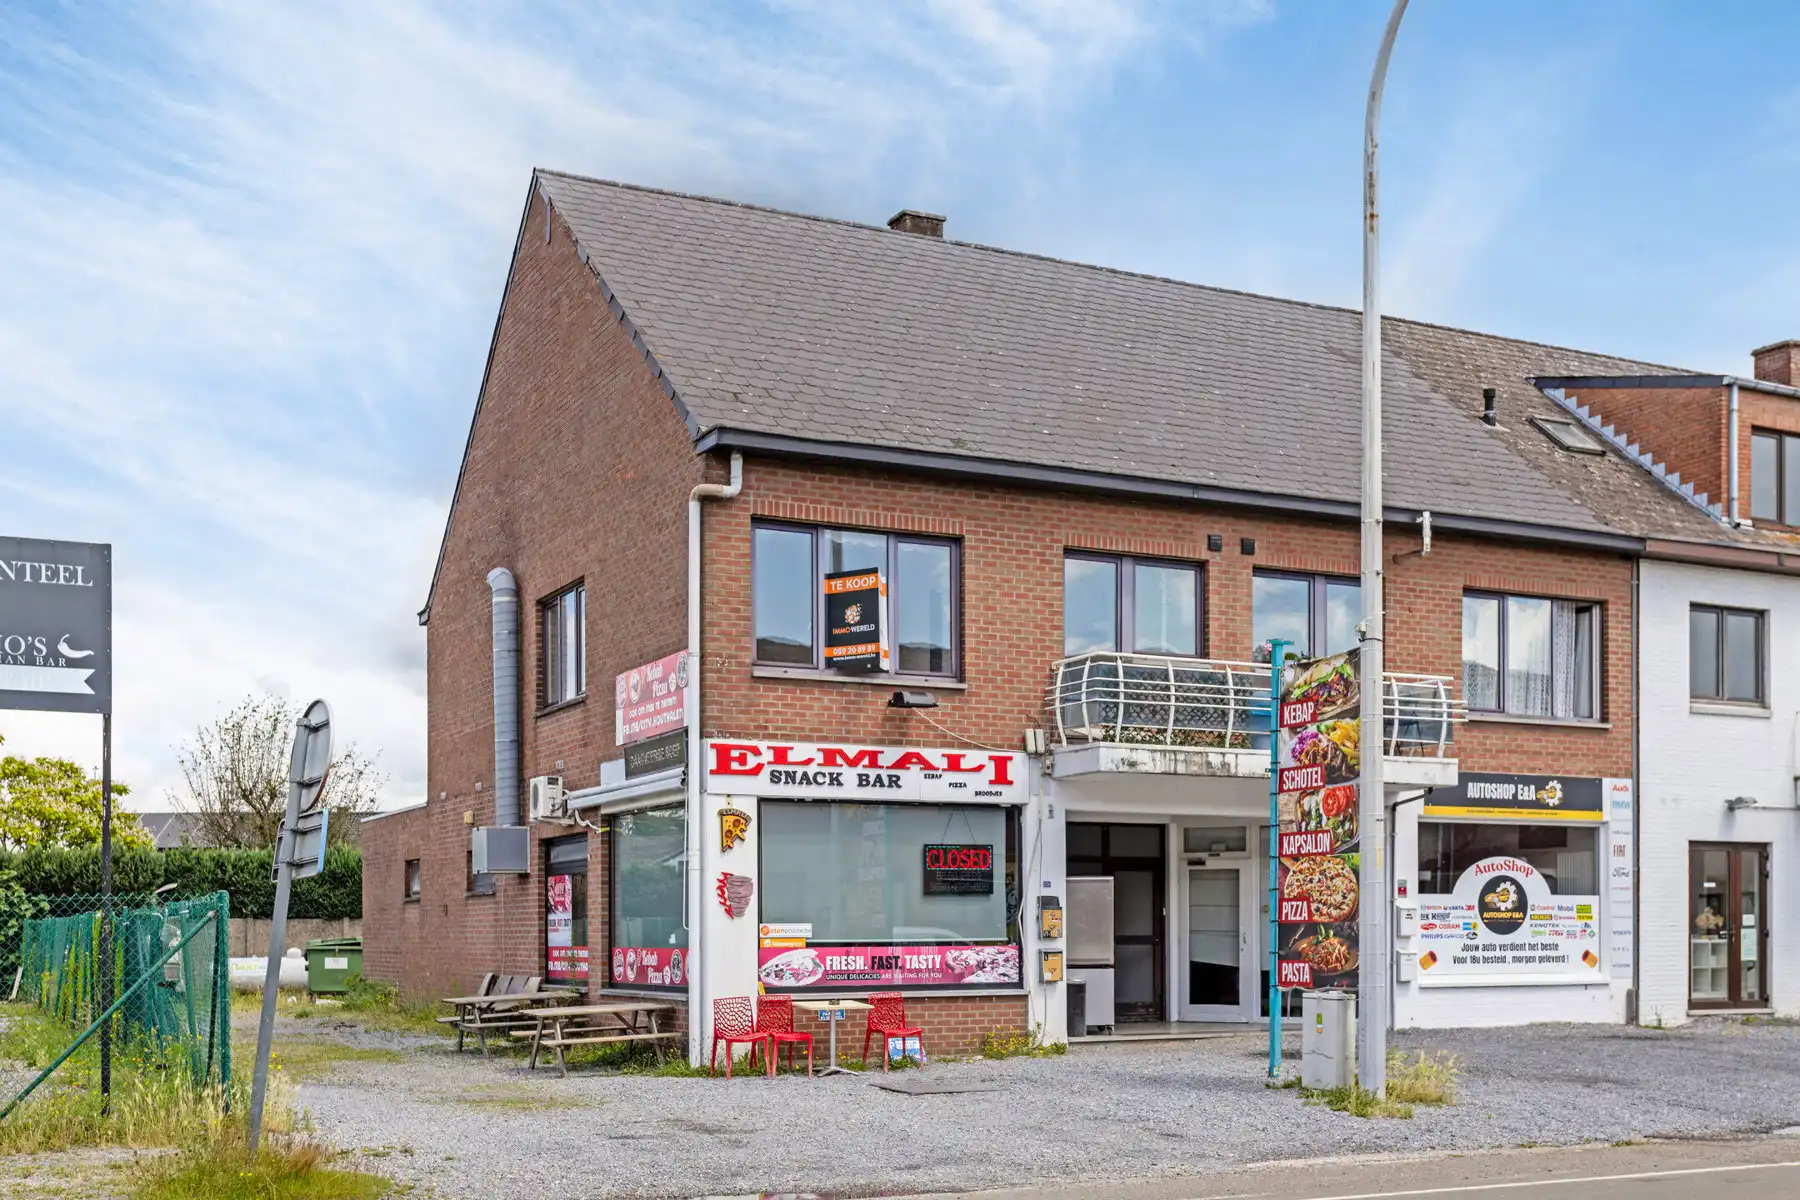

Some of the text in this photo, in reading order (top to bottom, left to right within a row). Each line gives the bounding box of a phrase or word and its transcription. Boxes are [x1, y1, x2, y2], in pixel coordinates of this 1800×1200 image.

[830, 576, 876, 591] TE KOOP
[36, 656, 66, 667] BAR
[1283, 701, 1315, 725] KEBAP
[709, 743, 1014, 785] ELMALI
[769, 769, 903, 789] SNACK BAR
[1283, 766, 1323, 790] SCHOTEL
[1467, 782, 1536, 801] AUTOSHOP E&A
[1282, 832, 1331, 855] KAPSALON
[1613, 845, 1626, 857] FIAT
[927, 849, 990, 869] CLOSED
[1475, 859, 1534, 878] AutoShop
[1282, 901, 1309, 921] PIZZA
[1461, 941, 1559, 953] Jouw auto verdient het beste
[825, 954, 942, 970] FRESH. FAST. TASTY
[1452, 955, 1468, 965] Voor
[1469, 955, 1480, 964] 18u
[1482, 954, 1507, 964] besteld
[1511, 954, 1537, 965] morgen
[1538, 954, 1566, 965] geleverd
[1281, 962, 1311, 983] PASTA
